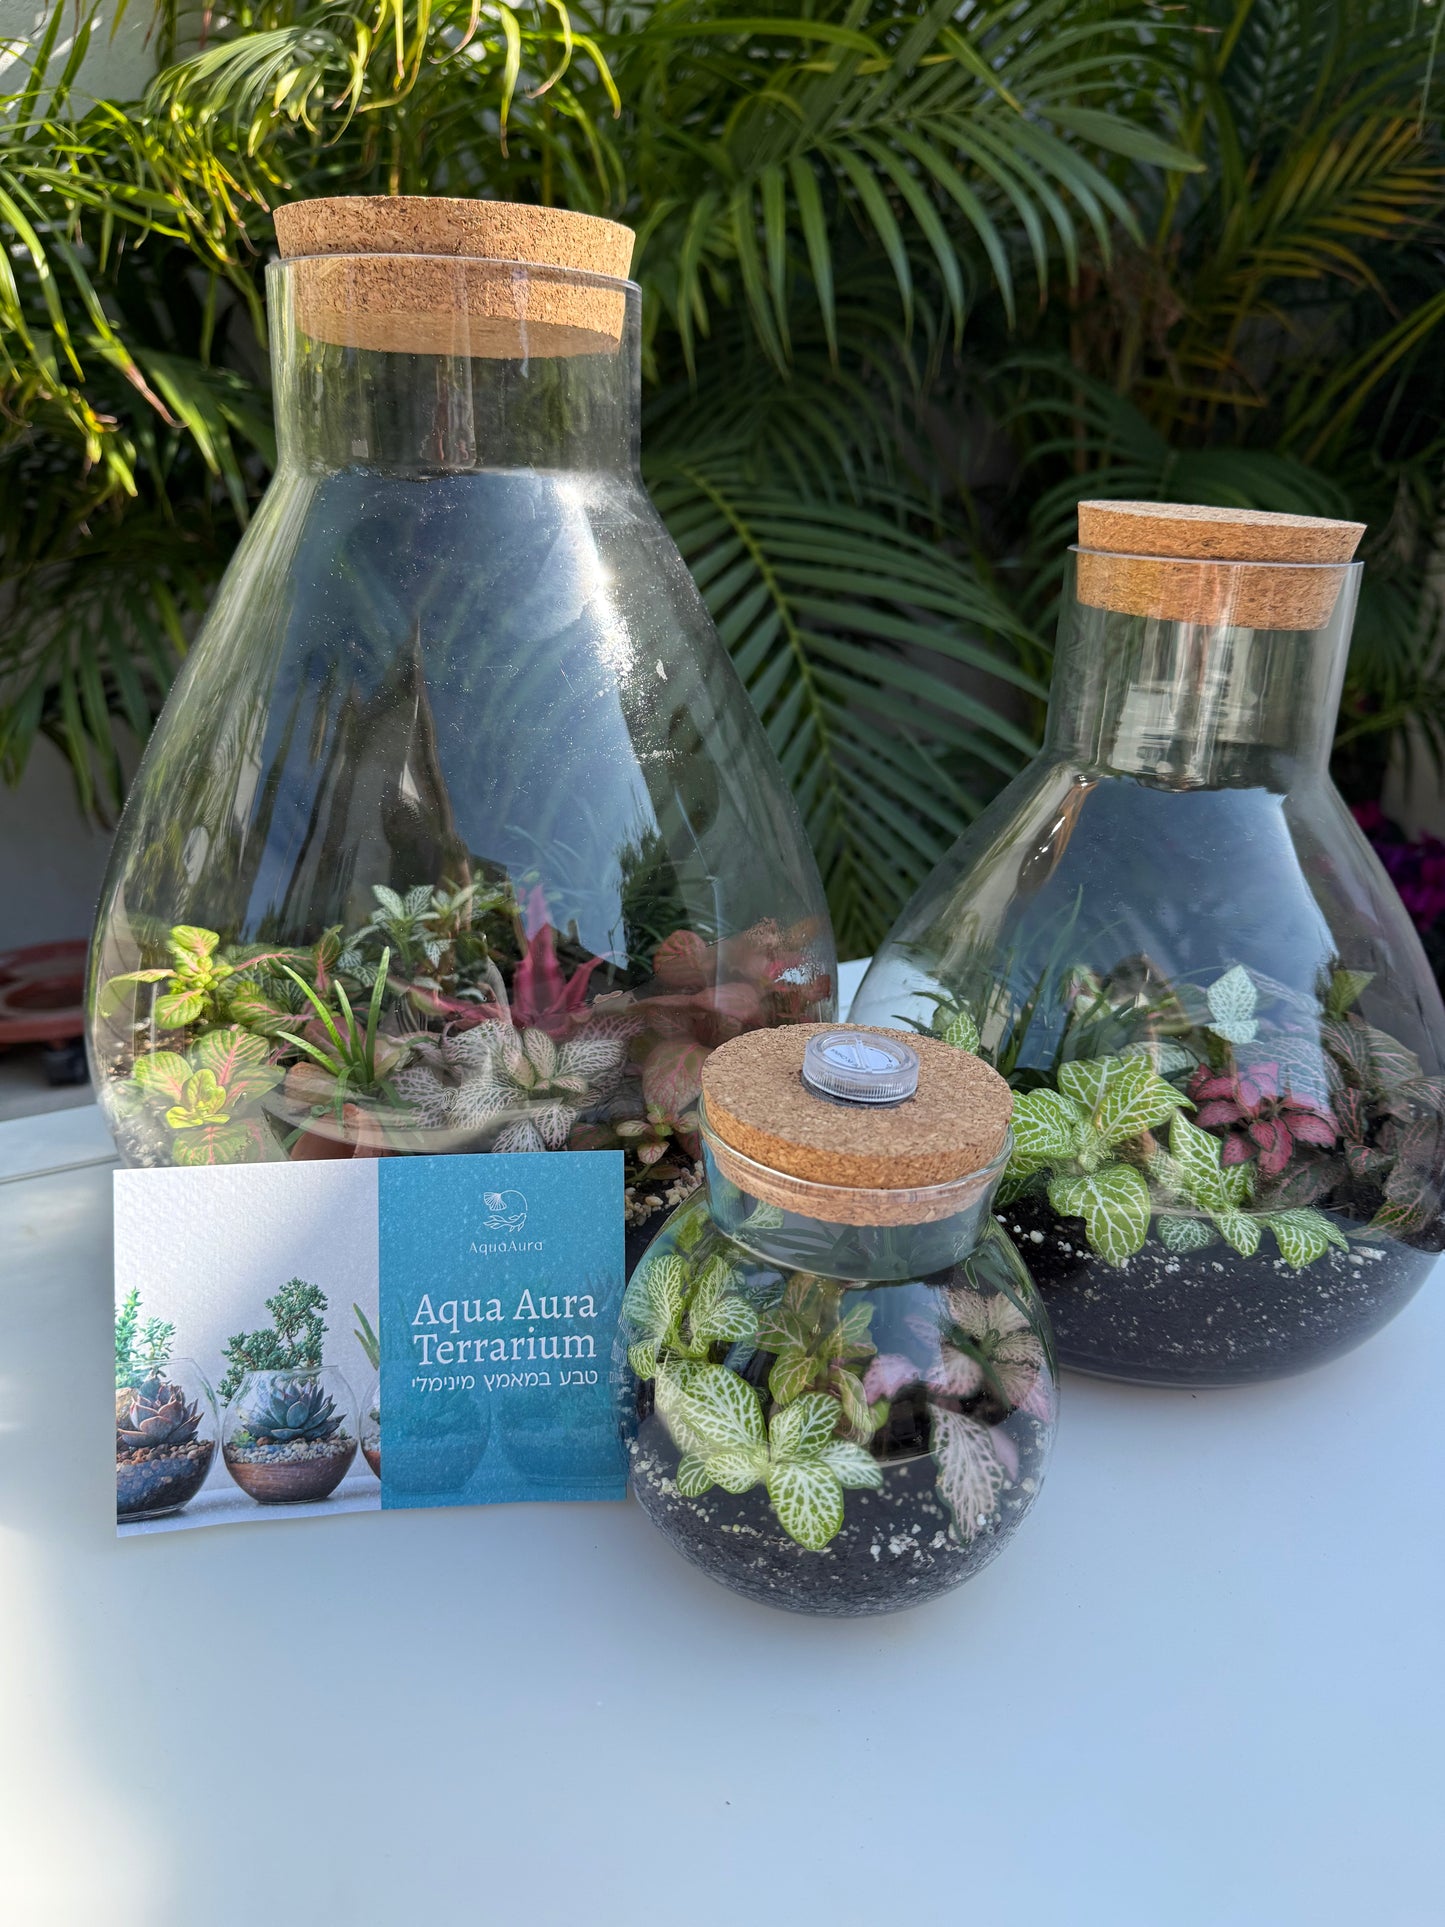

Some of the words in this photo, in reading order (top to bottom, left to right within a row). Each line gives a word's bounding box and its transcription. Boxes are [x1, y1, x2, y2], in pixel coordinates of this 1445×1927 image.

[469, 1240, 543, 1256] AquaAura
[411, 1293, 505, 1334] Aqua
[512, 1288, 599, 1321] Aura
[412, 1326, 598, 1366] Terrarium
[411, 1374, 476, 1393] מינימלי
[483, 1371, 552, 1392] במאמץ
[559, 1370, 599, 1387] טבע
